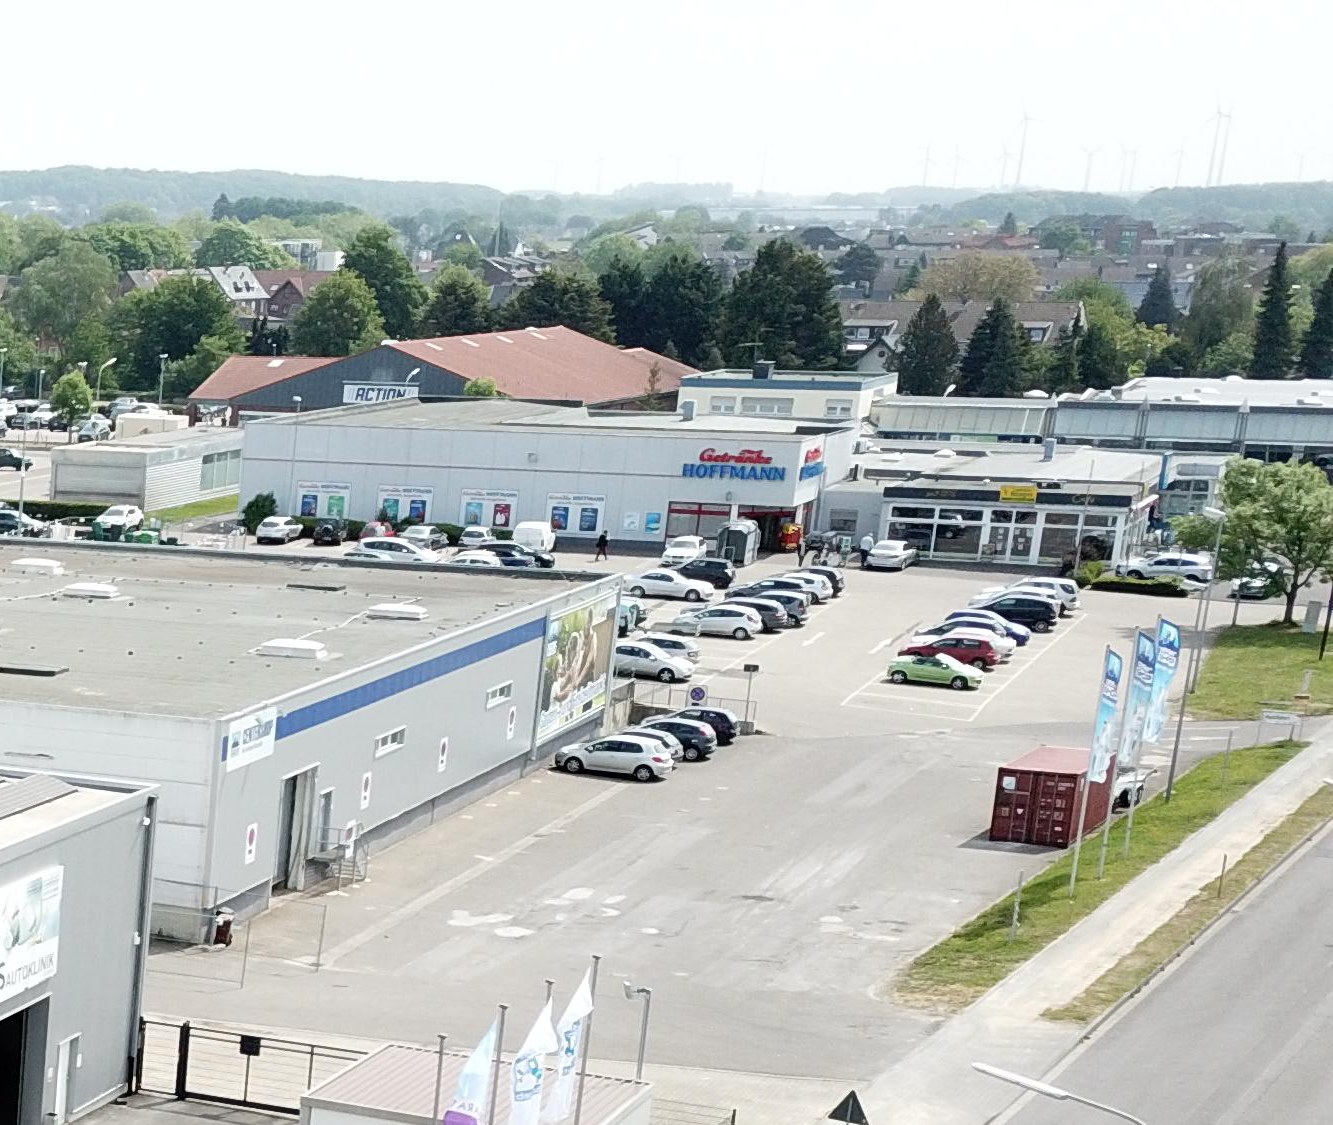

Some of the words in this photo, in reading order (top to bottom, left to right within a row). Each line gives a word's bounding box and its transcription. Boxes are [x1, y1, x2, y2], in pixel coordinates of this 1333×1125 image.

[355, 387, 407, 402] ACTION
[682, 463, 787, 482] HOFFMANN
[5, 951, 54, 988] AUTOKLINIK
